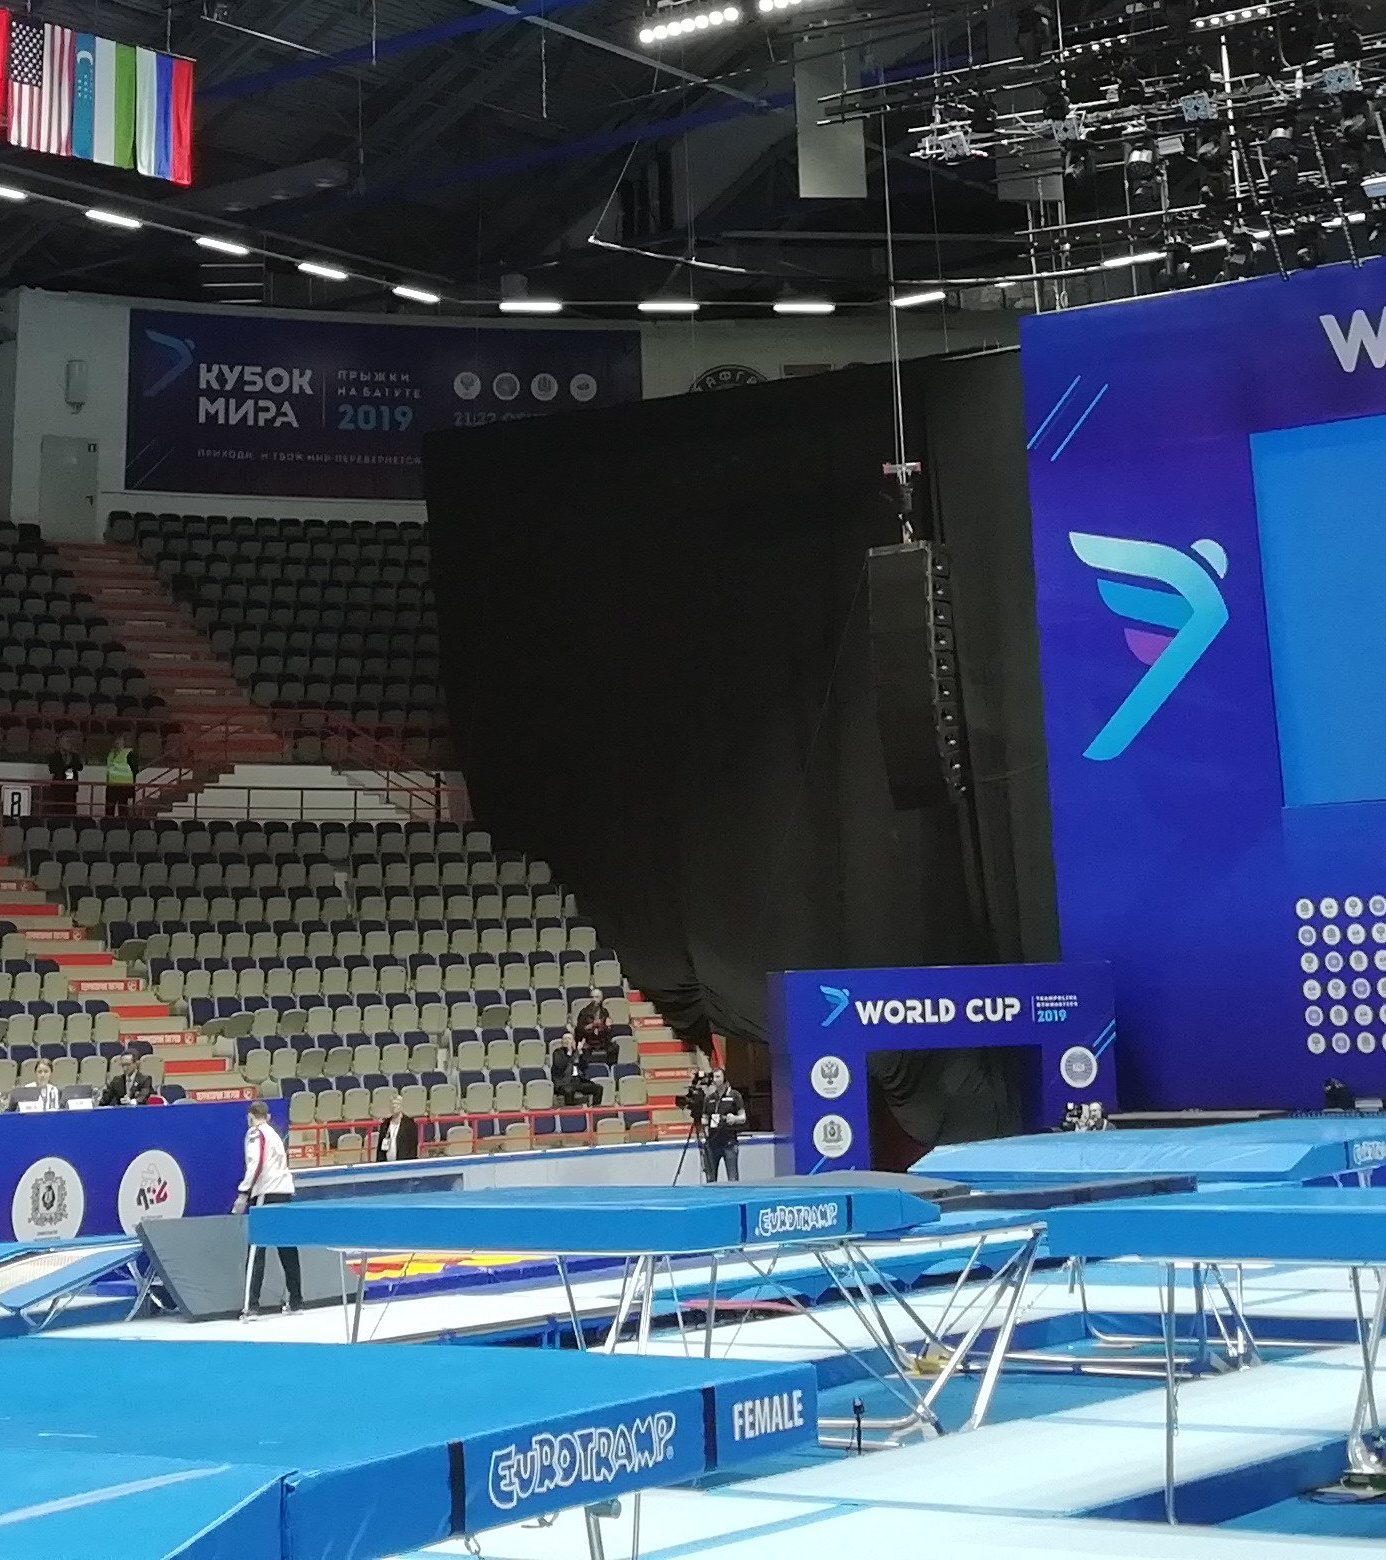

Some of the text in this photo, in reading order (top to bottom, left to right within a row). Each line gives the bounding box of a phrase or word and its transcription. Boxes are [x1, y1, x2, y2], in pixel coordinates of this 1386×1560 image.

[197, 363, 313, 395] КУБОК
[336, 369, 410, 382] ПРЫЖКИ
[336, 386, 358, 397] НА
[197, 396, 300, 428] МИРА
[337, 403, 414, 431] 2019
[854, 997, 1021, 1026] WORLD CUP
[1037, 1009, 1068, 1024] 2019
[731, 1389, 805, 1442] FEMALE
[487, 1410, 677, 1510] EUROTRAMP
